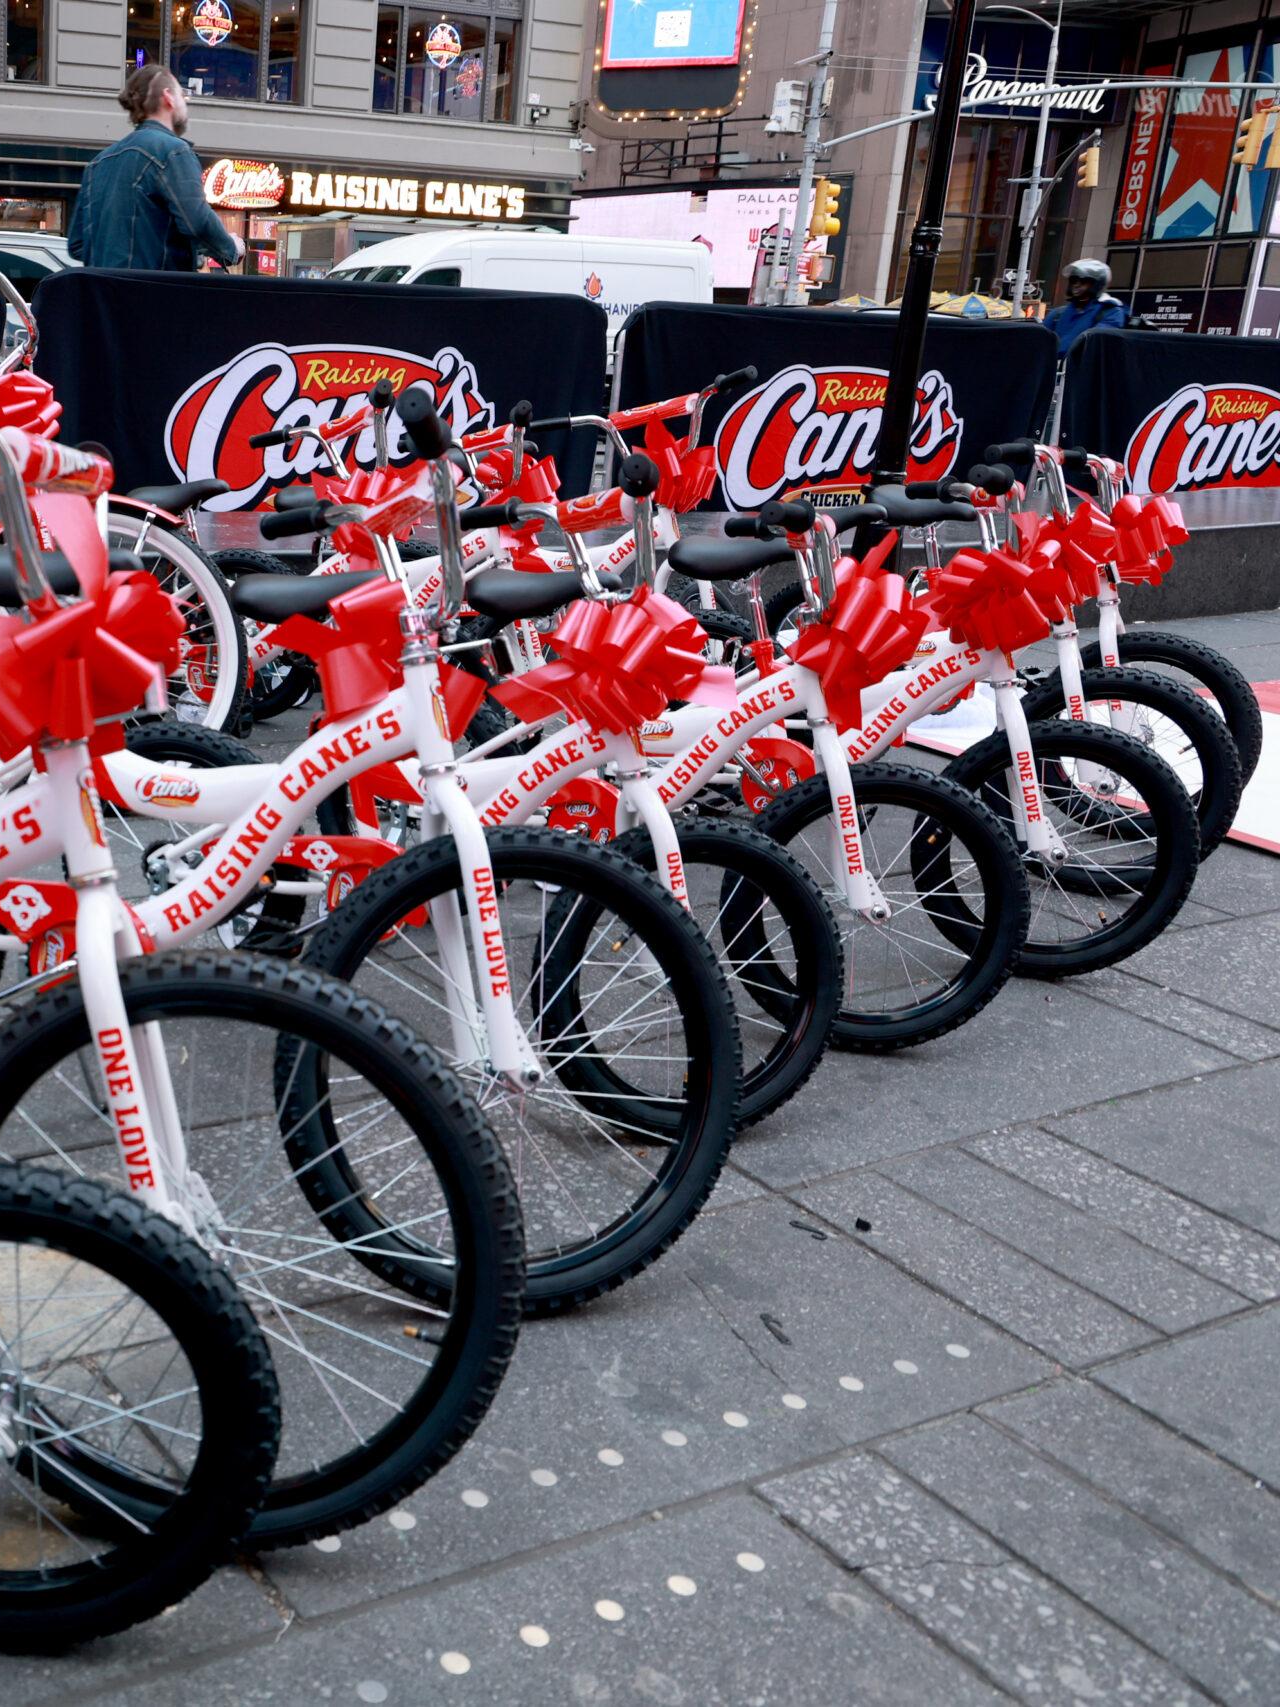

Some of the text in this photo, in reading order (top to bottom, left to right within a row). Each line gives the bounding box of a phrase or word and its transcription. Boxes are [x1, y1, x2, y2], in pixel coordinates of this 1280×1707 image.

[204, 159, 284, 203] Cane's
[290, 172, 525, 219] RAISING CANE'S
[1126, 160, 1147, 209] CBS
[302, 359, 406, 392] Raising
[819, 379, 887, 405] Raisin
[1208, 395, 1268, 420] Raising
[725, 368, 958, 508] Can's
[800, 491, 861, 507] CHICKEN
[847, 648, 981, 762] AISING CANE'S
[517, 732, 607, 792] CANE'S
[657, 680, 797, 804] AISING CANE'S
[136, 772, 200, 805] Cane's
[1017, 750, 1041, 823] ONE LOVE
[164, 709, 402, 933] RAISING CANE'S
[837, 794, 863, 876] ONE LOVE
[666, 852, 685, 896] ONE
[474, 867, 510, 998] ONE LOVE
[97, 1027, 156, 1192] ONE LOVE
